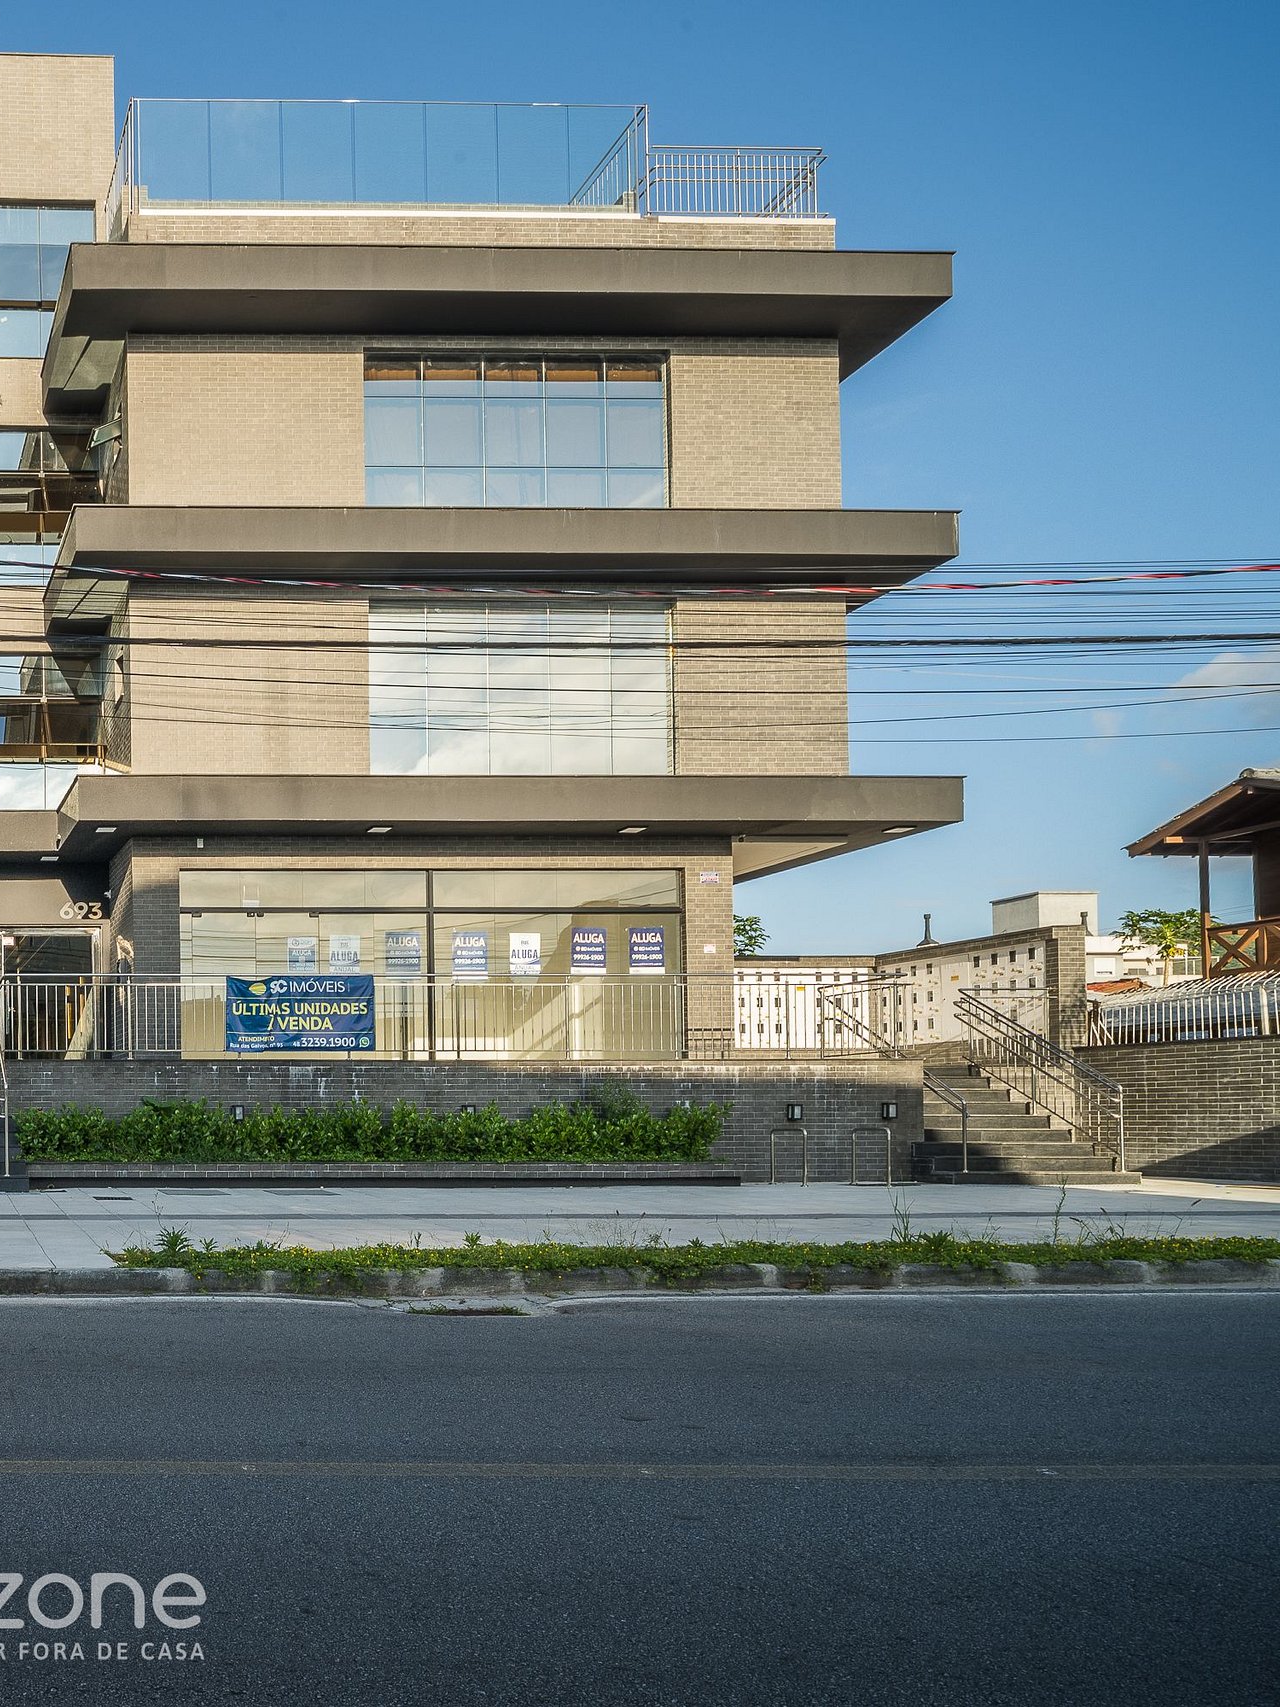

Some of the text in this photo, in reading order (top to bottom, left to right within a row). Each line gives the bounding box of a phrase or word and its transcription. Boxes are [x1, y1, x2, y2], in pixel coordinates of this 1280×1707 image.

[59, 902, 103, 920] 693
[387, 937, 418, 947] ALUGA
[454, 937, 486, 947] ALUGA
[573, 933, 605, 943] ALUGA
[631, 933, 662, 943] ALUGA
[291, 949, 312, 957] ALUGA
[330, 951, 358, 961] ALUGA
[511, 949, 539, 959] ALUGA
[290, 978, 345, 993] IMÓVEIS
[232, 1001, 368, 1016] ÚLTIMAS UNIDADES
[277, 1016, 334, 1031] VENDA
[301, 1037, 356, 1048] 3239.1900
